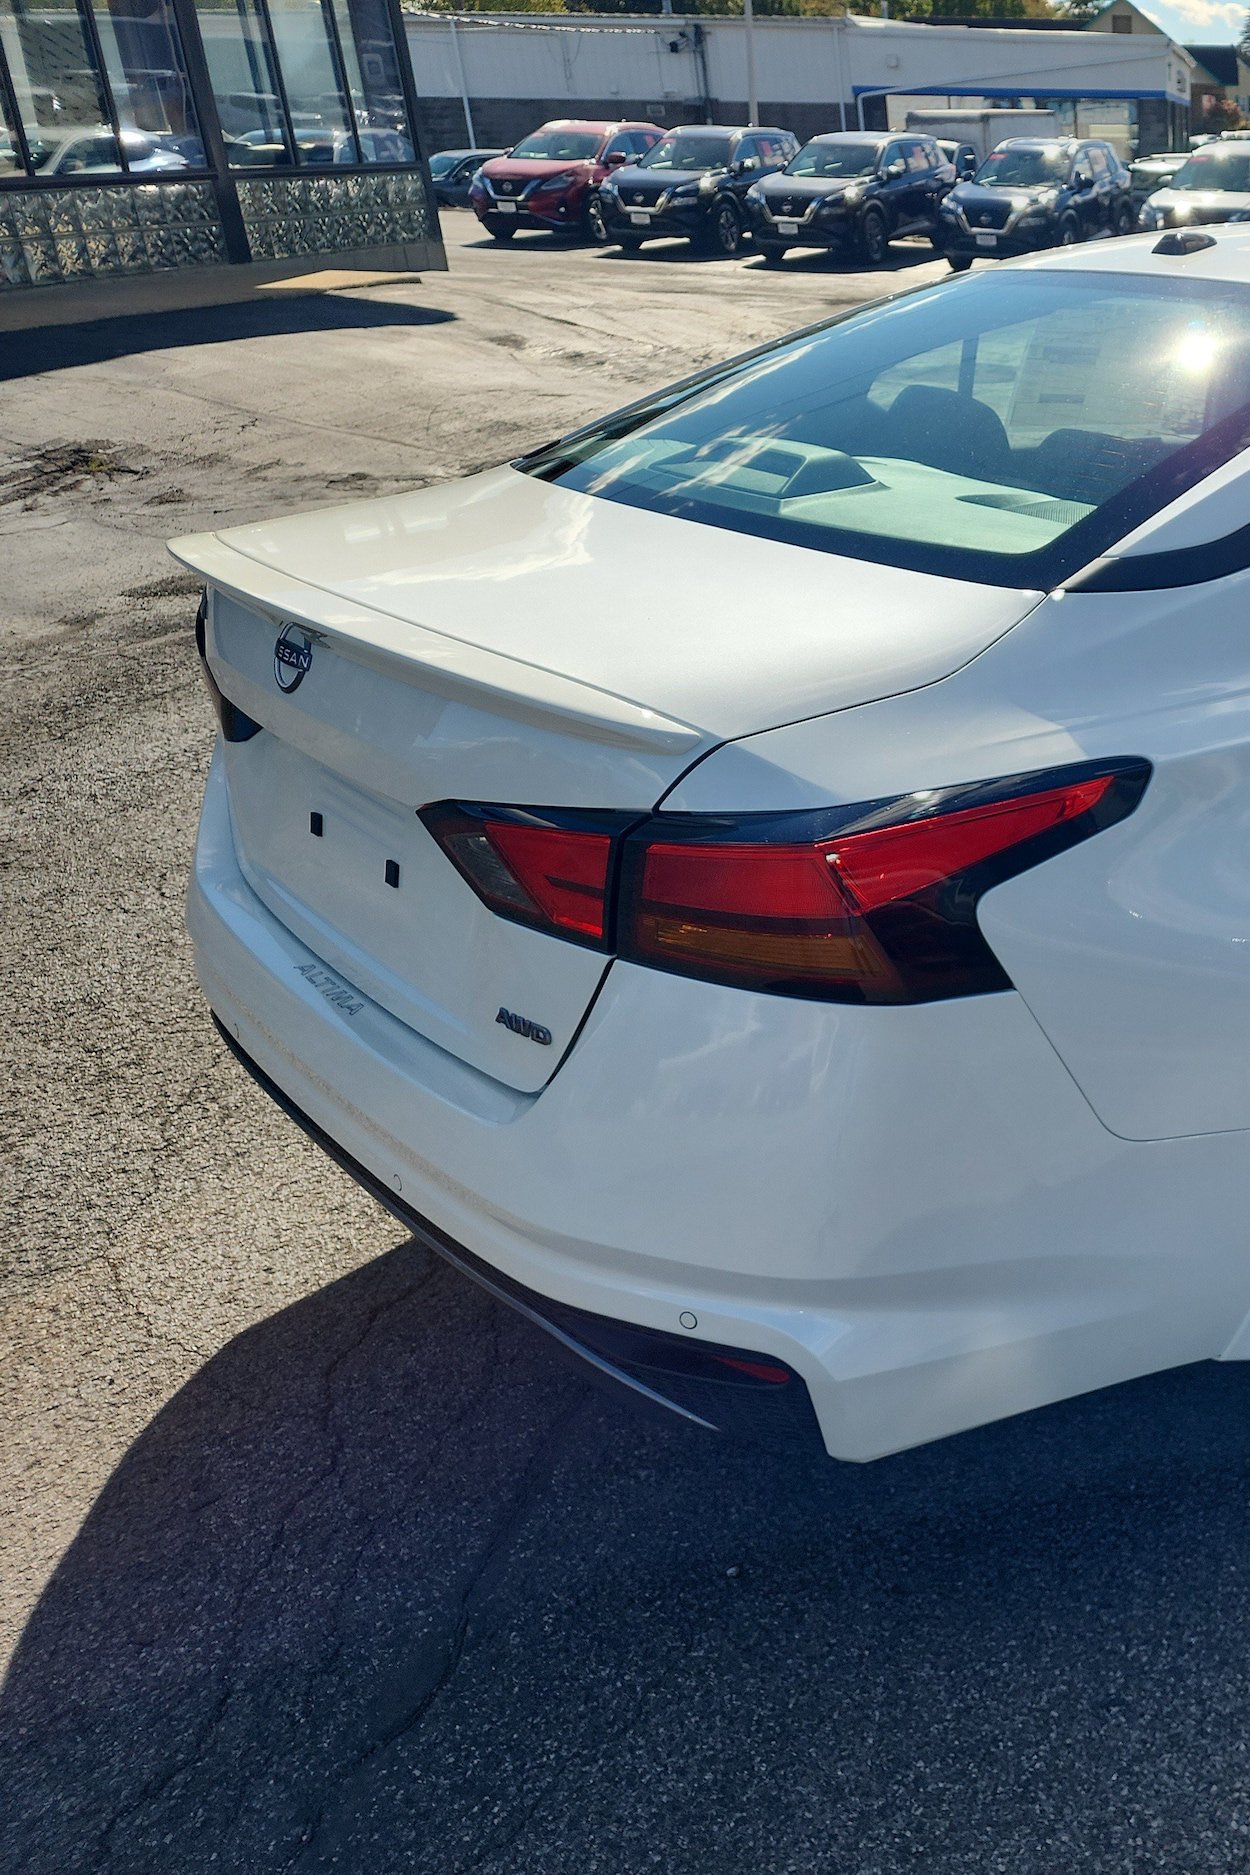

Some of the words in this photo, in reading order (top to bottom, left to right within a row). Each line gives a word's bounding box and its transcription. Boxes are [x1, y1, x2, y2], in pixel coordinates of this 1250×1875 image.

[277, 644, 310, 668] SSAN
[293, 964, 364, 1015] ALTIMA
[495, 1007, 552, 1045] AWD
